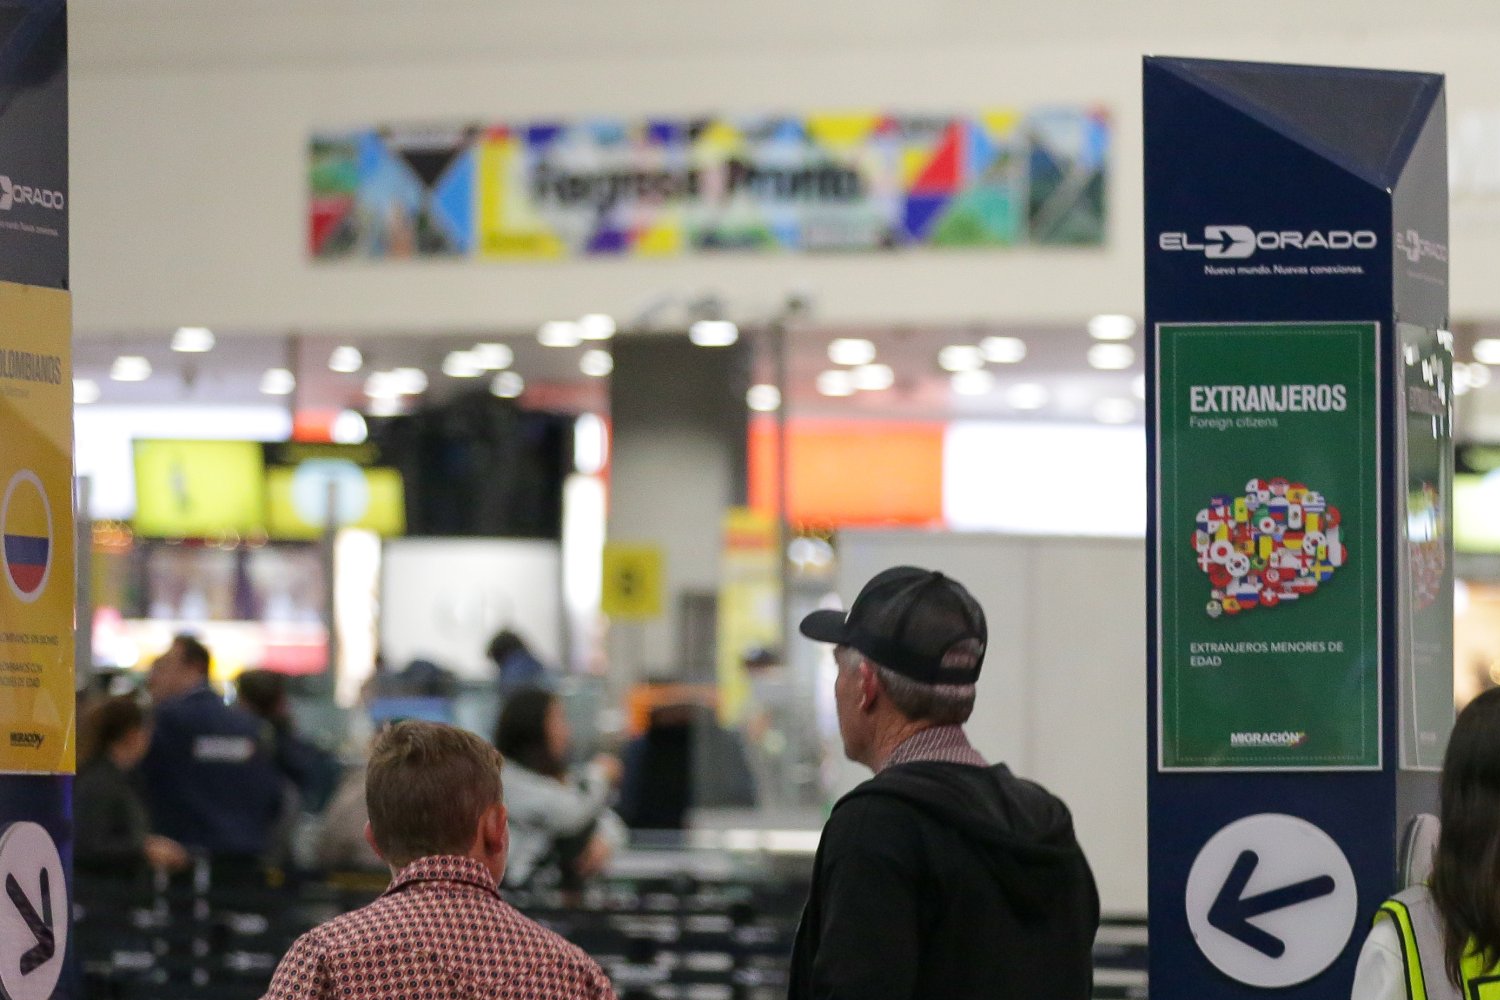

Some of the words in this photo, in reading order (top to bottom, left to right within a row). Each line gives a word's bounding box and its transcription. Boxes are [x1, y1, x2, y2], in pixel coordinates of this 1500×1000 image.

[1159, 231, 1205, 251] EL
[1204, 225, 1378, 259] DORADO
[1204, 264, 1236, 275] Nuevo
[1189, 384, 1348, 413] EXTRANJEROS
[1189, 416, 1234, 431] Foreign
[1235, 416, 1279, 428] citizens
[1190, 642, 1268, 654] EXTRANJEROS
[1270, 641, 1326, 653] MENORES
[1328, 641, 1344, 652] DE
[1190, 656, 1222, 667] EDAD
[1230, 730, 1301, 744] MIGRACIÓN
